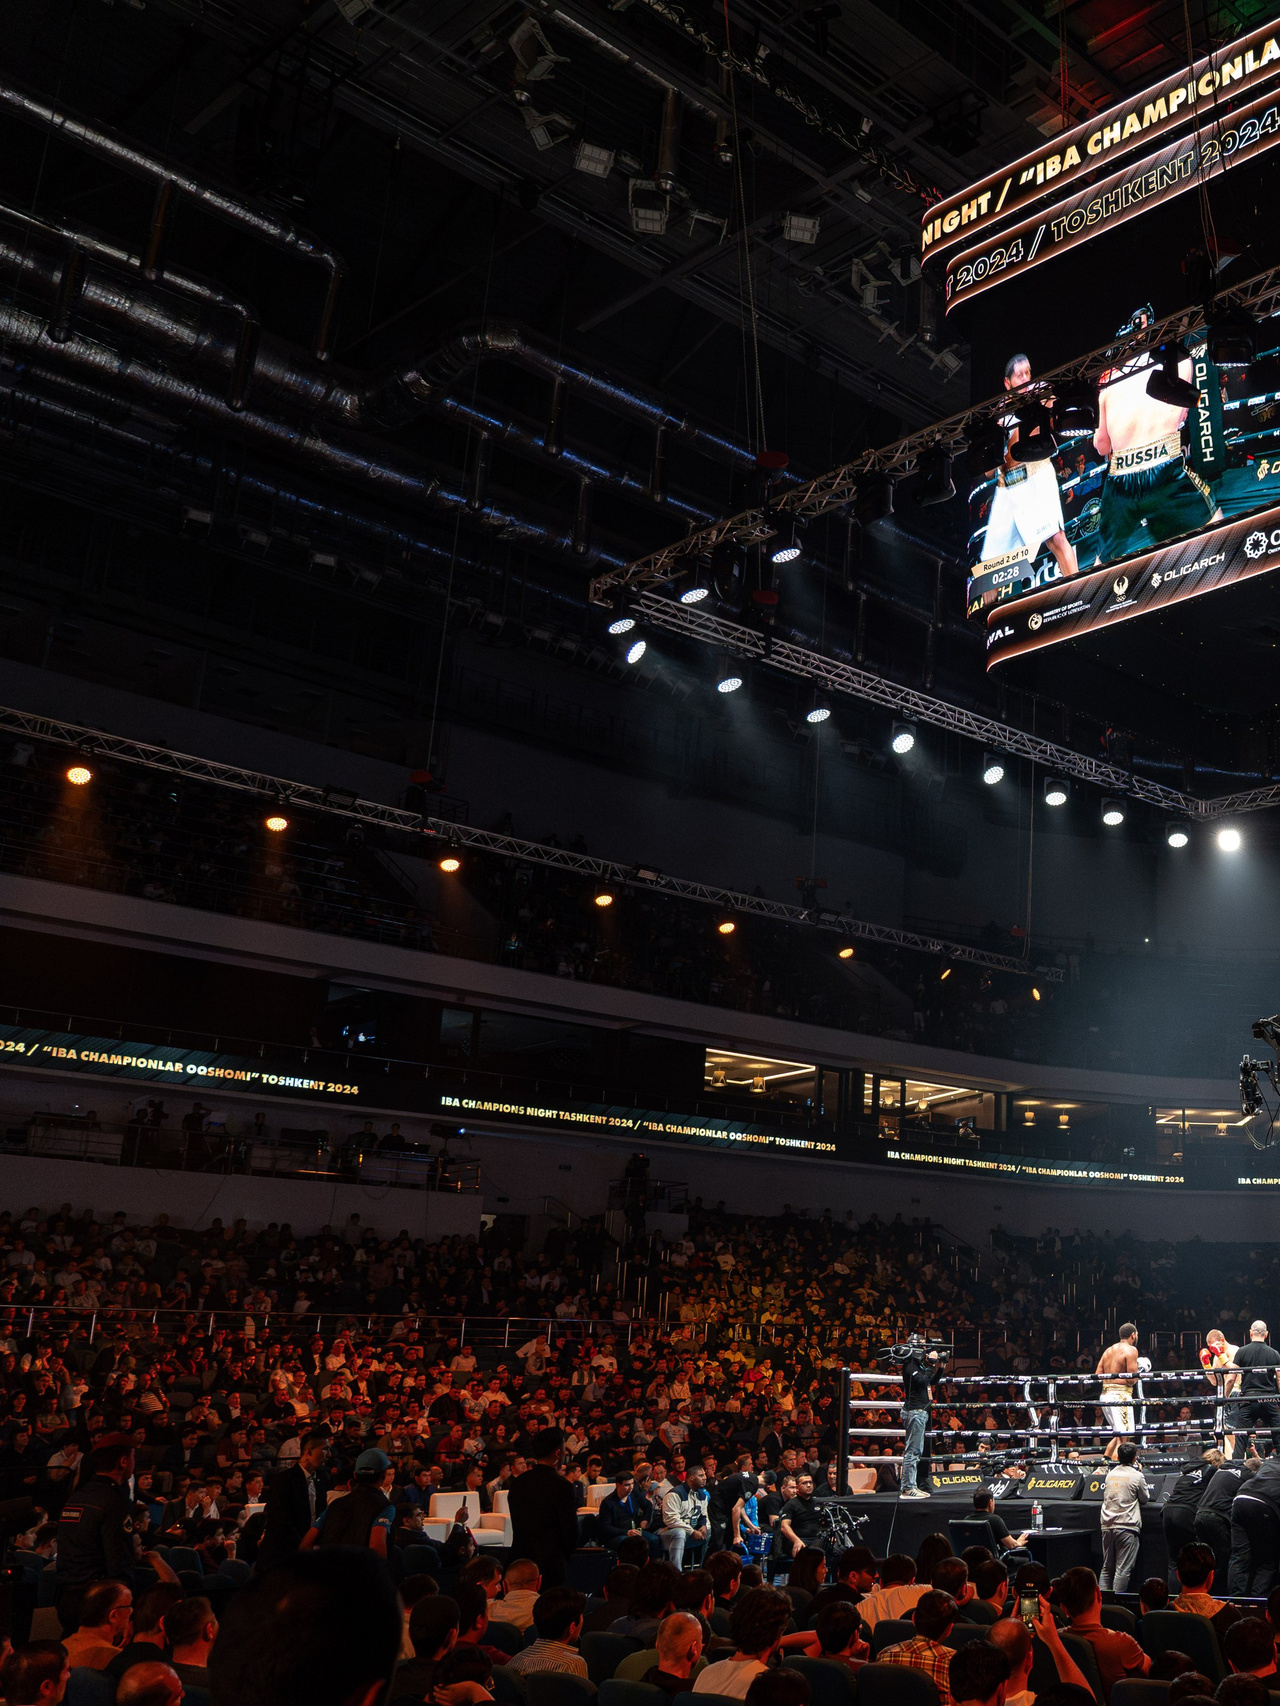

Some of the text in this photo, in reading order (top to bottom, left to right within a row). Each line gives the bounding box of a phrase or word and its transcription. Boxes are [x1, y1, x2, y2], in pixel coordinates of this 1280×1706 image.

[956, 239, 1024, 292] 2024
[1051, 151, 1194, 242] TOSHKENT
[1201, 107, 1280, 168] 2024
[921, 191, 992, 252] NIGHT
[1115, 444, 1169, 470] RUSSIA
[983, 560, 1005, 571] Round
[1011, 553, 1020, 561] of
[1021, 549, 1029, 557] 10
[1164, 552, 1226, 581] OLIGARCH
[992, 566, 1019, 585] 02:28
[80, 1051, 184, 1073] CHAMPIONLAR
[261, 1074, 326, 1091] TOSHKENT
[326, 1083, 359, 1095] 2024
[441, 1096, 460, 1107] IBA
[461, 1099, 525, 1115] CHAMPIONS
[526, 1107, 558, 1119] NIGHT
[558, 1111, 608, 1125] TASHKENT
[608, 1117, 634, 1128] 2024
[665, 1124, 728, 1139] CHAMPIONLAR
[775, 1137, 816, 1150] TOSHKENT
[816, 1142, 836, 1152] 2024
[887, 1151, 900, 1159] IBA
[900, 1152, 943, 1164] CHAMPIONS
[943, 1156, 965, 1166] NIGHT
[965, 1159, 998, 1170] TASHKENT
[998, 1163, 1016, 1172] 2024
[1038, 1168, 1088, 1178] CHAMPIONLAR
[1129, 1173, 1164, 1183] TOSHKENT
[1237, 1177, 1251, 1185] IBA
[942, 1475, 982, 1484] OLIGARCH
[1035, 1479, 1076, 1488] OLIGARCH
